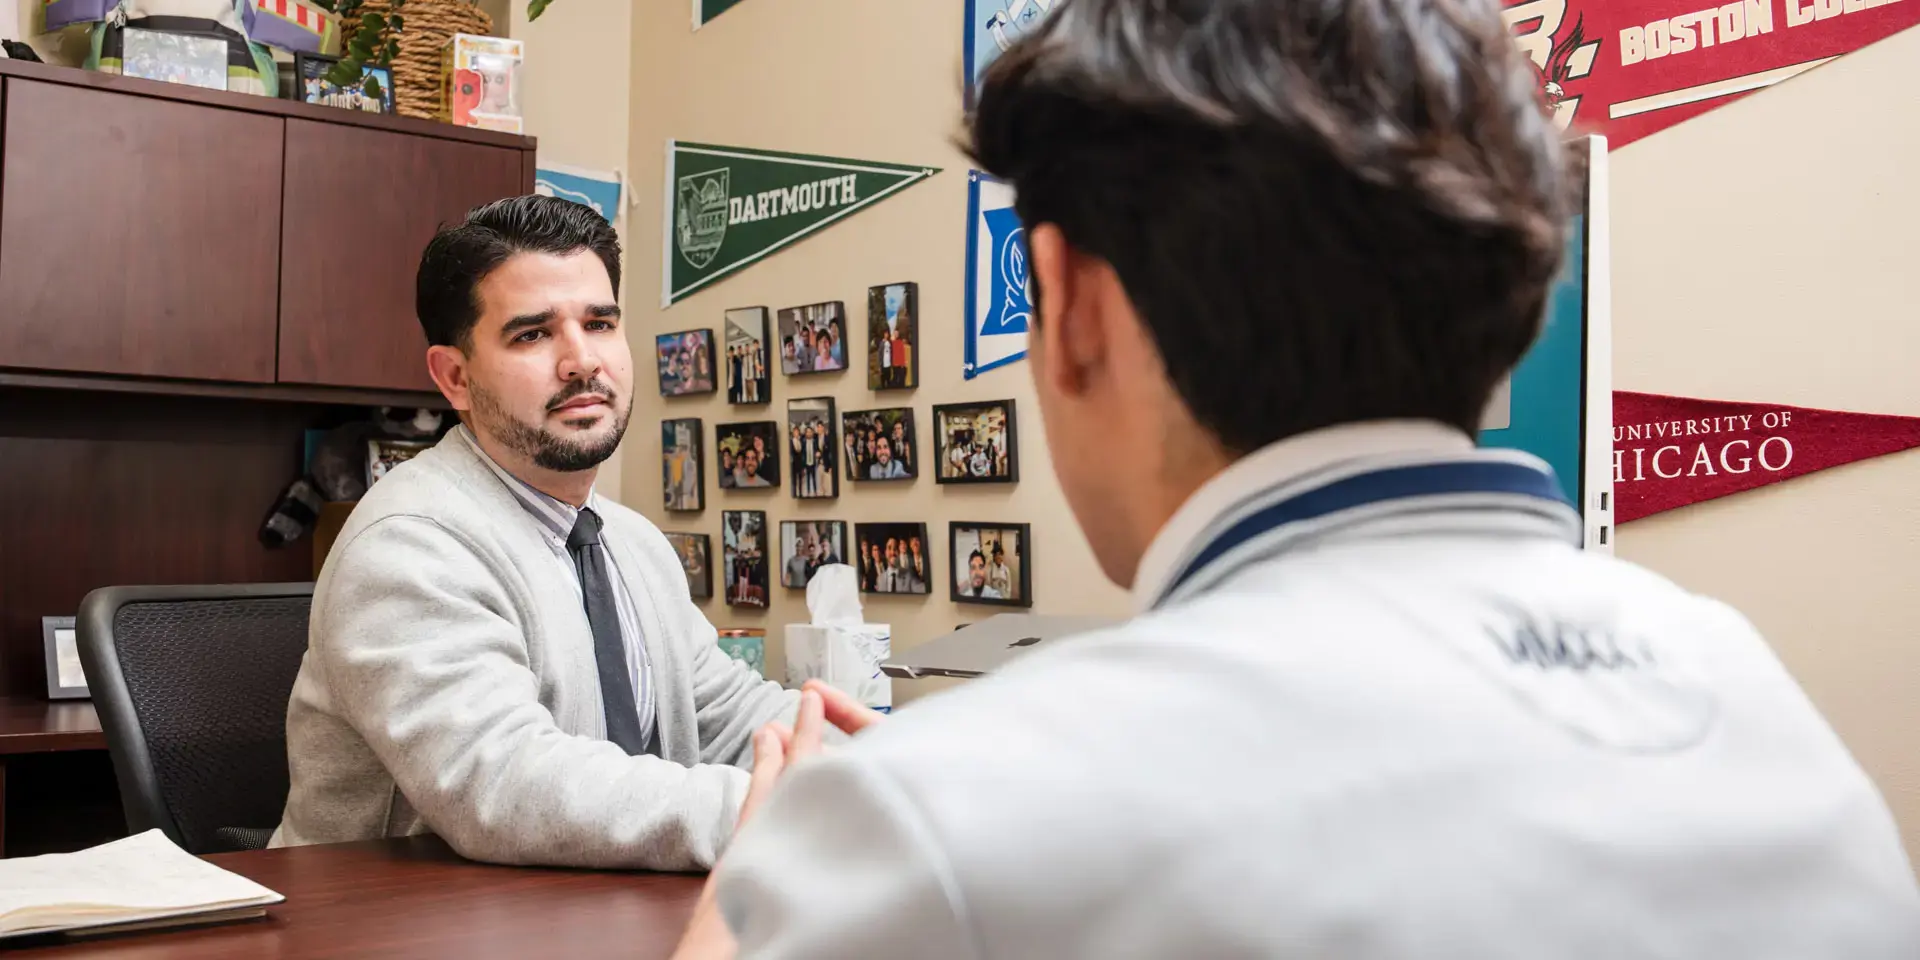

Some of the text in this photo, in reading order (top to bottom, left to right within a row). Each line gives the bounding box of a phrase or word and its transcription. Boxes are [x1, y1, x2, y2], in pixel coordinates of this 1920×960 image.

[1619, 0, 1774, 66] BOSTON
[728, 173, 857, 225] DARTMOUTH
[1612, 411, 1792, 442] UNIVERSITY OF
[1612, 436, 1793, 482] ICAGO
